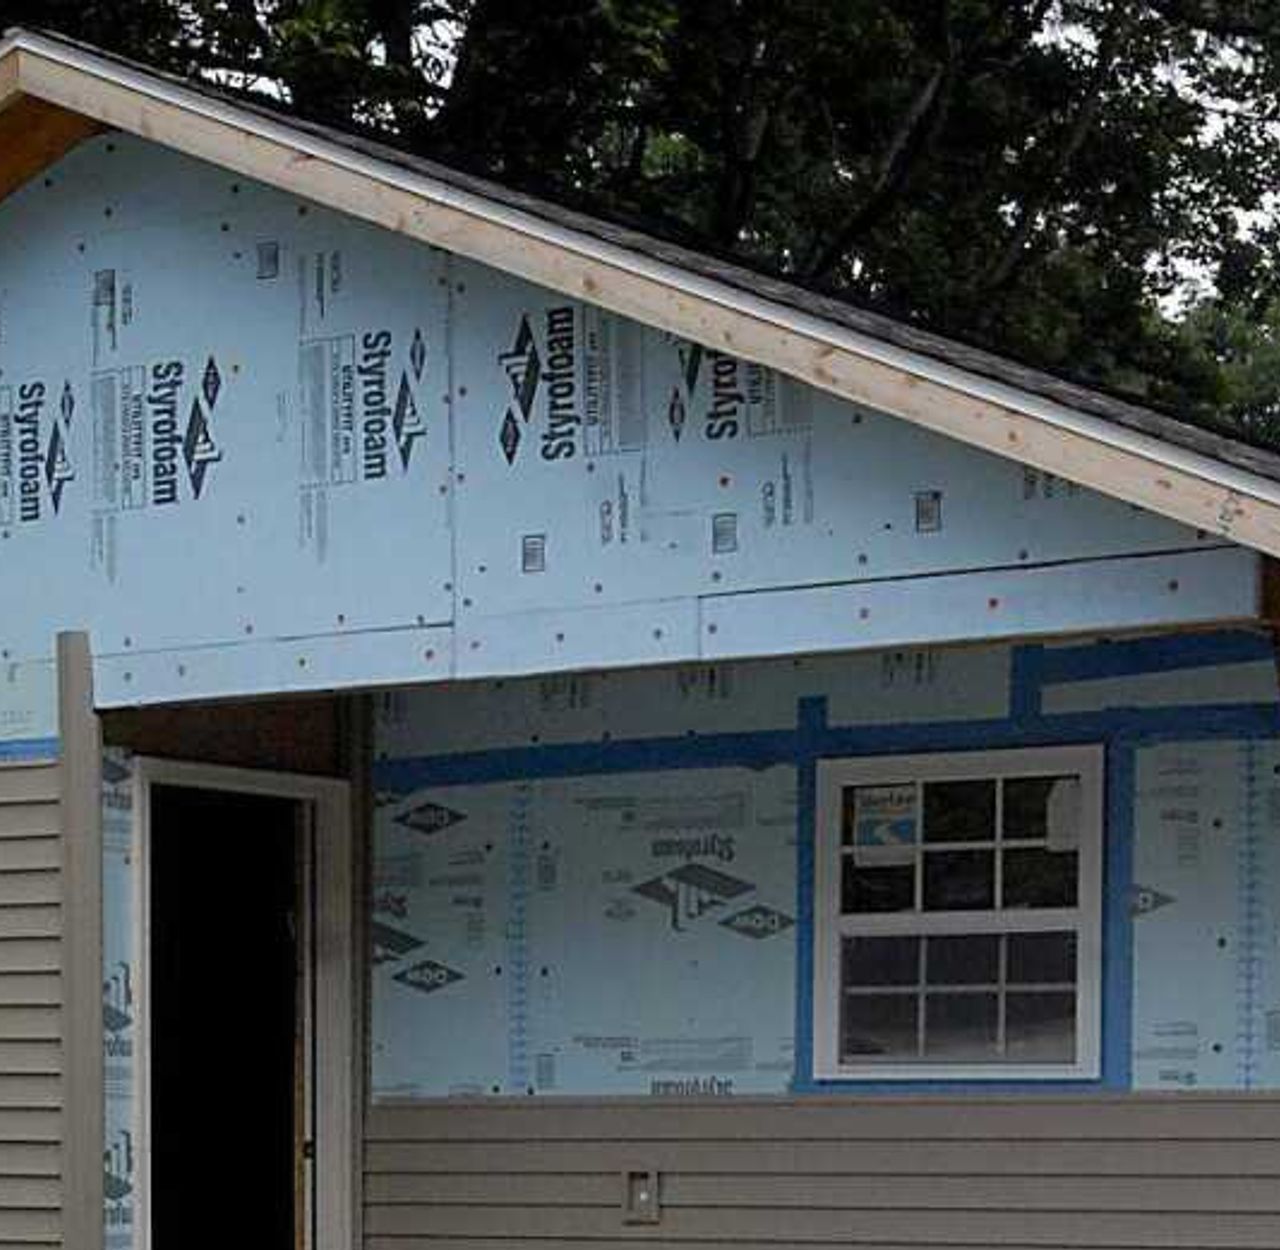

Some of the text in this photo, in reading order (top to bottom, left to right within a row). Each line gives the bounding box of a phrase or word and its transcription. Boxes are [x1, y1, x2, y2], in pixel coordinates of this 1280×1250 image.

[14, 382, 46, 522] Styrofoam
[146, 360, 184, 505] Styrofoam
[357, 329, 392, 481] Styrofoam
[541, 306, 582, 462] Styrofoam
